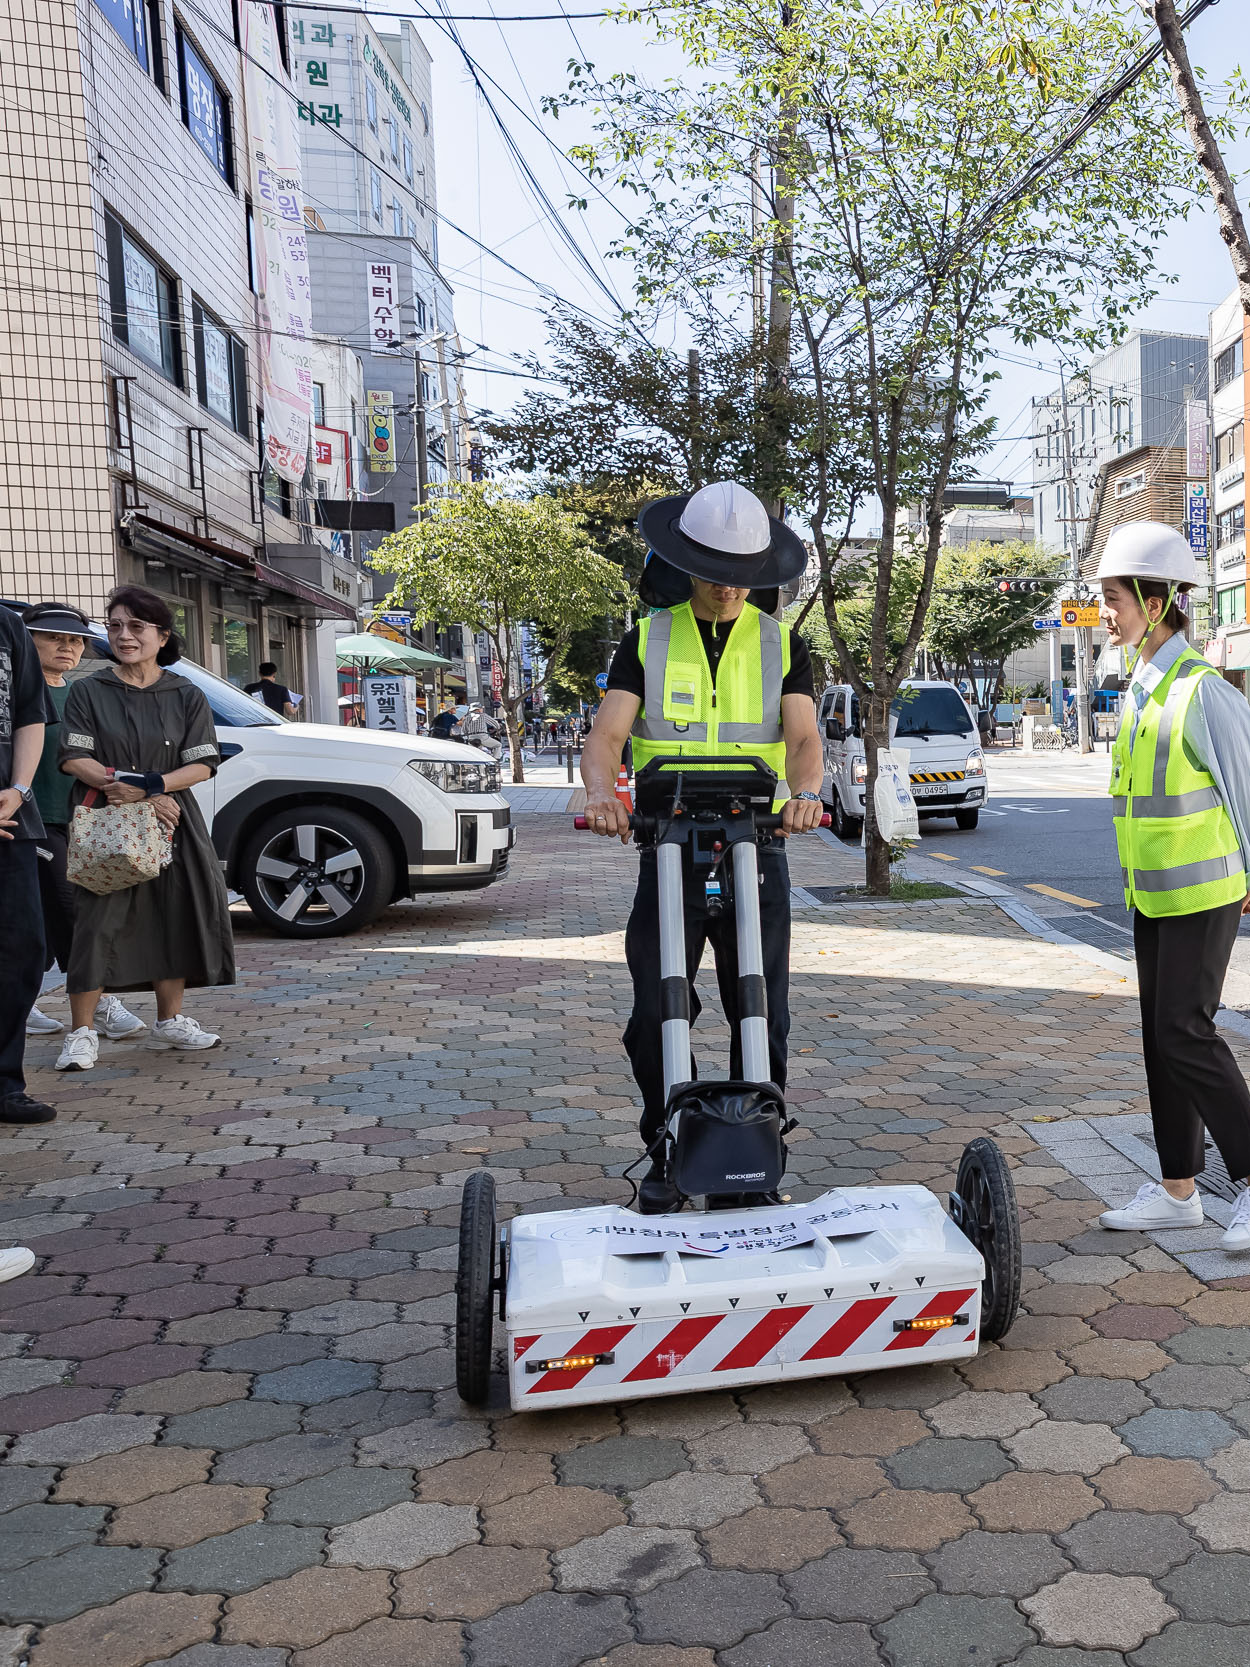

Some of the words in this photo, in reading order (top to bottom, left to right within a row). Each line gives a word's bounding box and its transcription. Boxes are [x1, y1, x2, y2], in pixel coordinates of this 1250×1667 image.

[1066, 613, 1075, 621] 30
[924, 786, 944, 795] 0495
[725, 1171, 766, 1181] ROCKBROS
[586, 1223, 688, 1241] 지반침하
[697, 1221, 798, 1241] 특별점검
[804, 1201, 902, 1226] 공동조사
